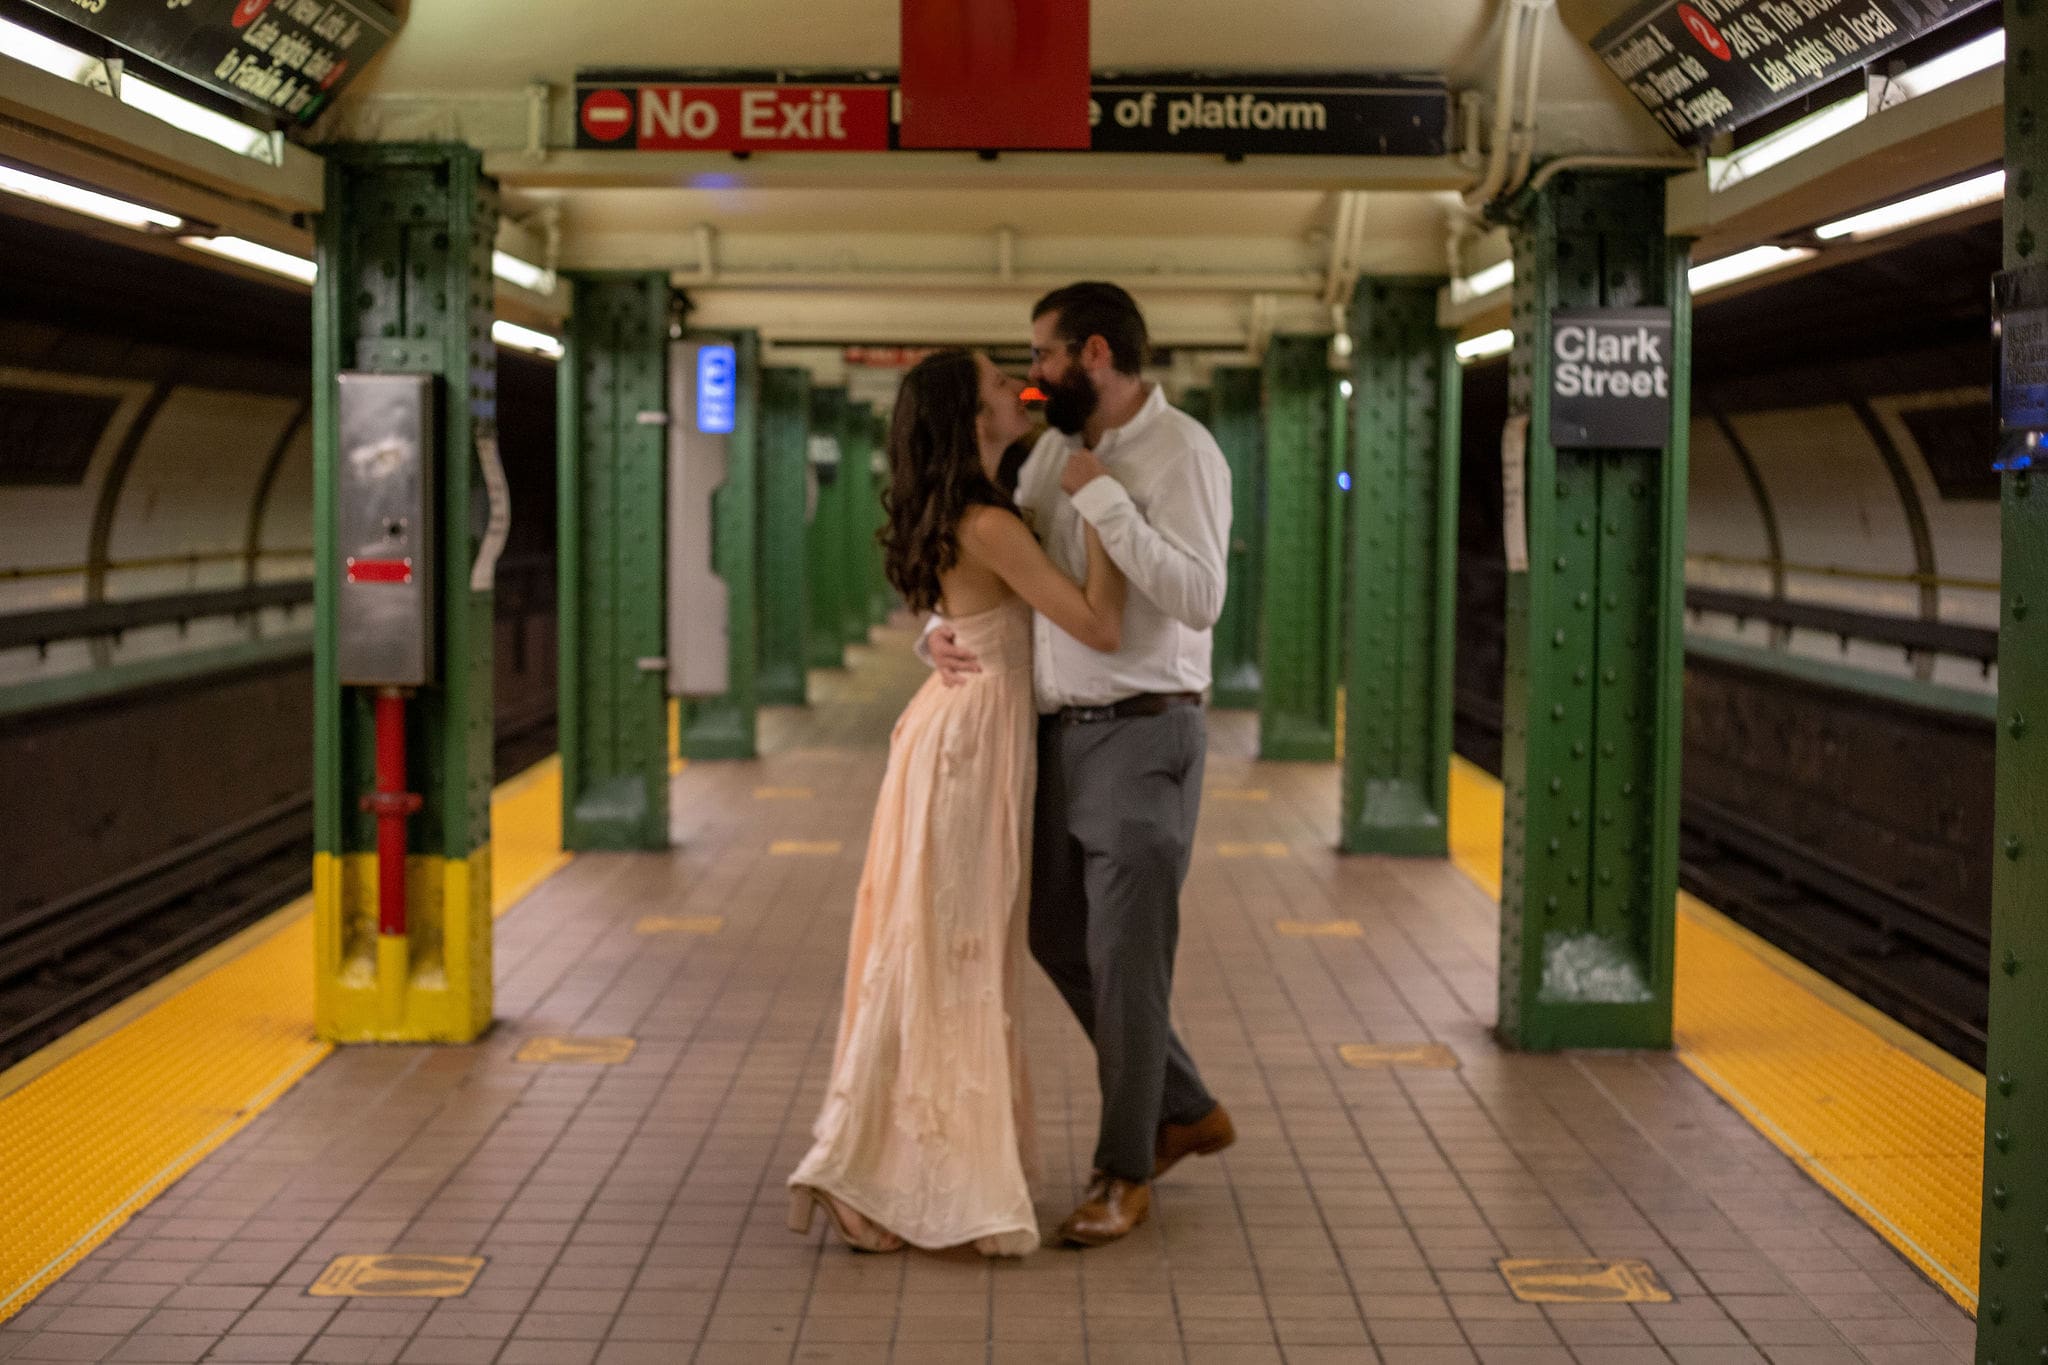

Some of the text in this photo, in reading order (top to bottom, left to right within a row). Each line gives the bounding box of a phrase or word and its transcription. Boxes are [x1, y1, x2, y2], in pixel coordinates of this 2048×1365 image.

[1688, 15, 1721, 49] 2
[1741, 12, 1784, 47] St,
[1758, 0, 1804, 35] The
[1719, 20, 1760, 60] 241
[1750, 0, 1898, 94] Late nights via local
[1678, 51, 1709, 83] via
[640, 90, 719, 140] No
[739, 90, 847, 140] Exit
[1114, 91, 1157, 128] of
[1167, 93, 1328, 136] platform
[1675, 87, 1734, 129] Express
[1554, 325, 1663, 364] Clark
[1554, 362, 1669, 398] Street
